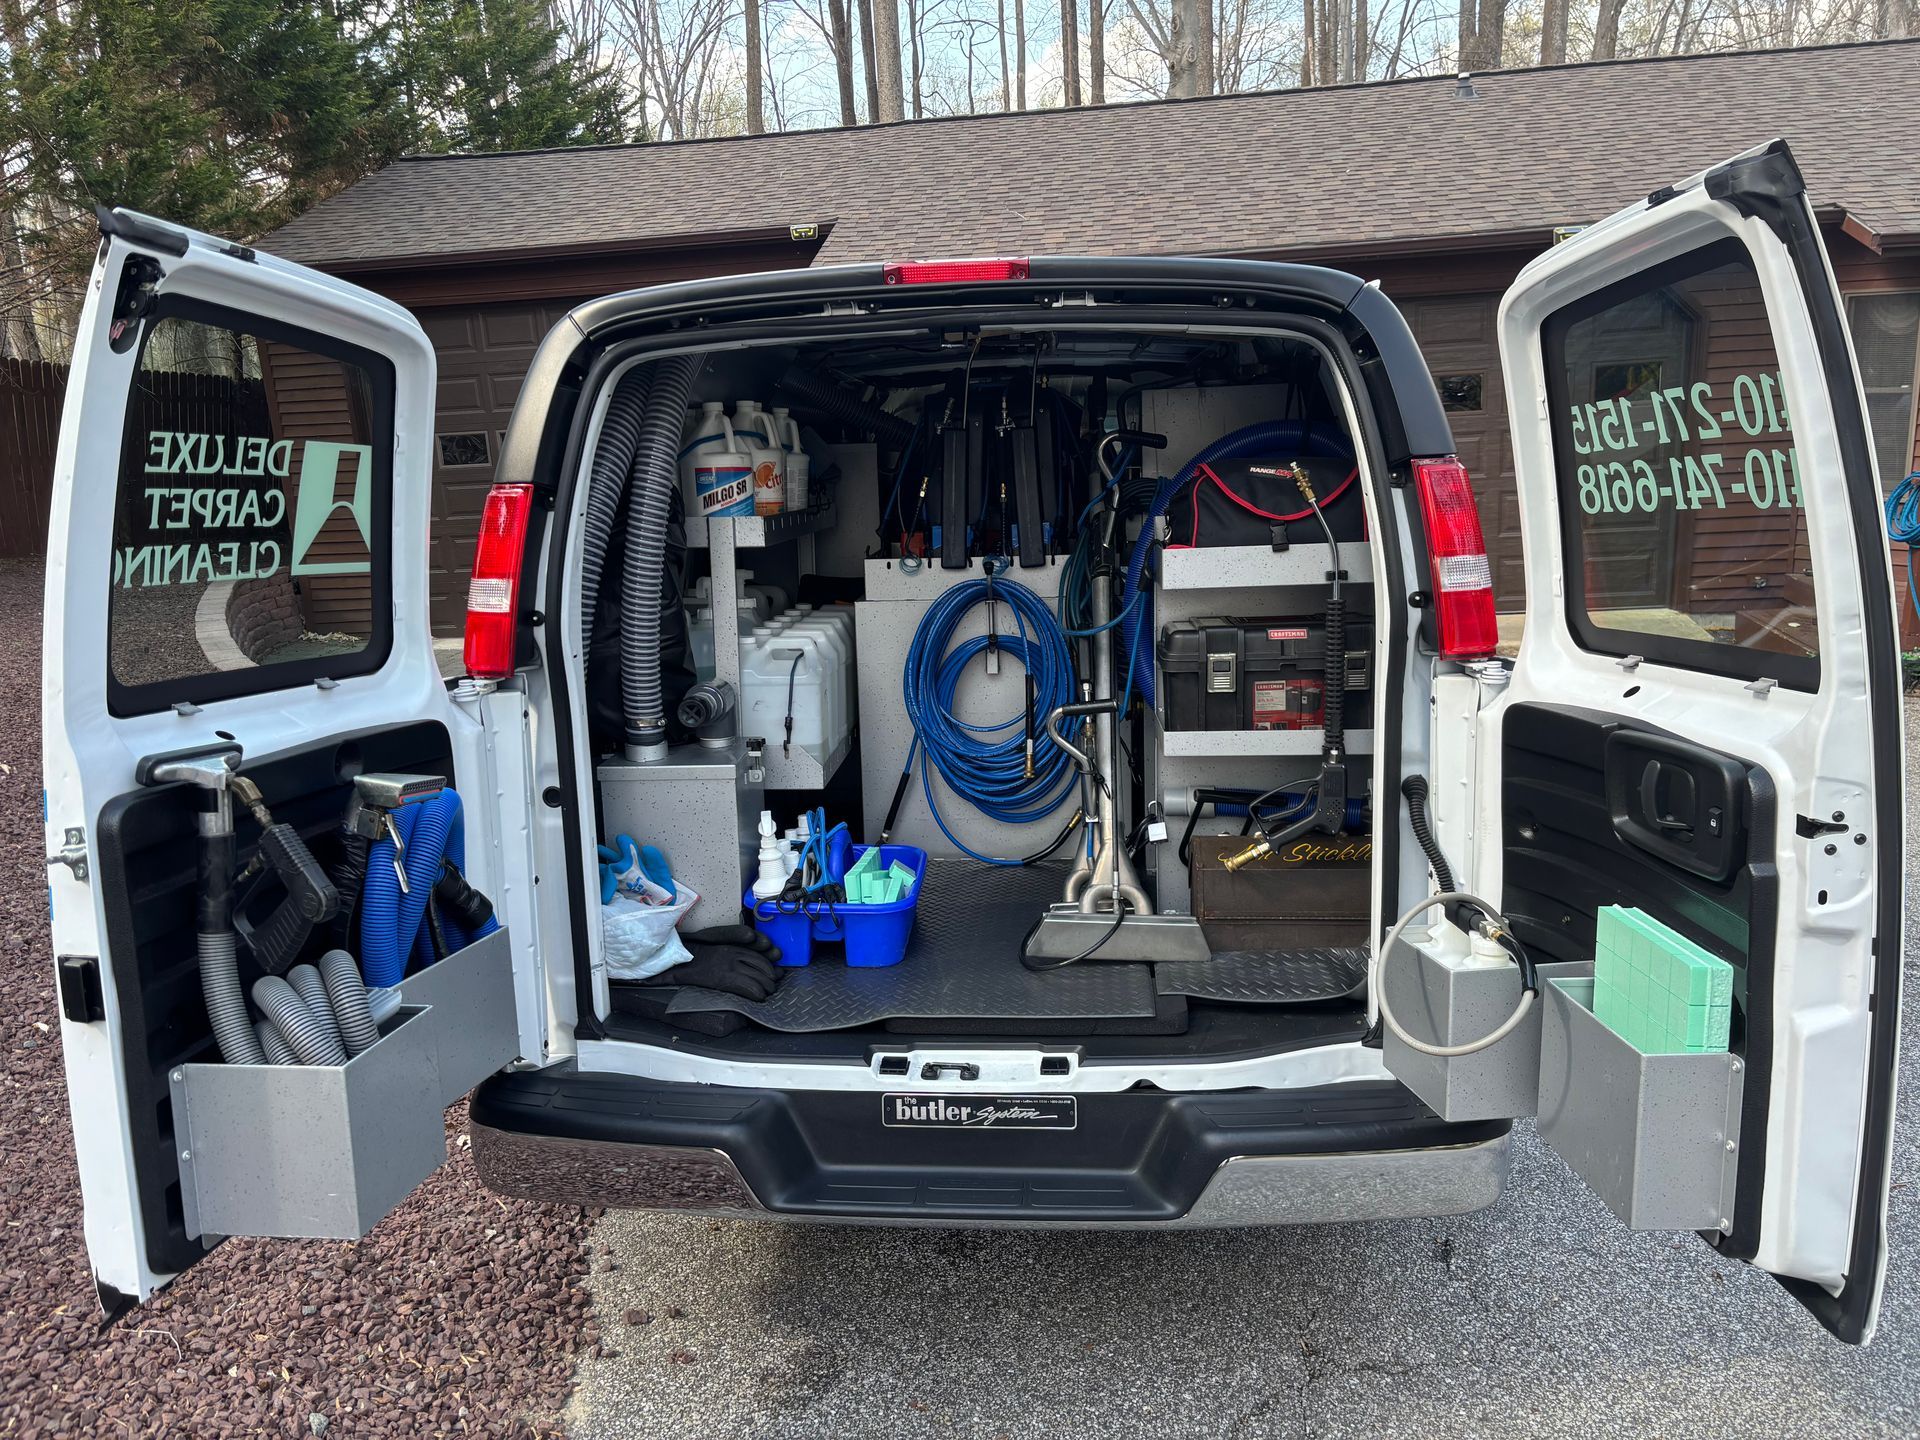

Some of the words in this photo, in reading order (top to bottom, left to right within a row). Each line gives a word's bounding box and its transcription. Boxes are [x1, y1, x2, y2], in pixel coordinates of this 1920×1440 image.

[703, 486, 734, 509] MILGO
[736, 479, 747, 496] SR
[1270, 630, 1305, 638] CRAFTSMAN
[904, 1096, 917, 1105] the
[896, 1098, 971, 1121] butler
[962, 1106, 1058, 1126] System
